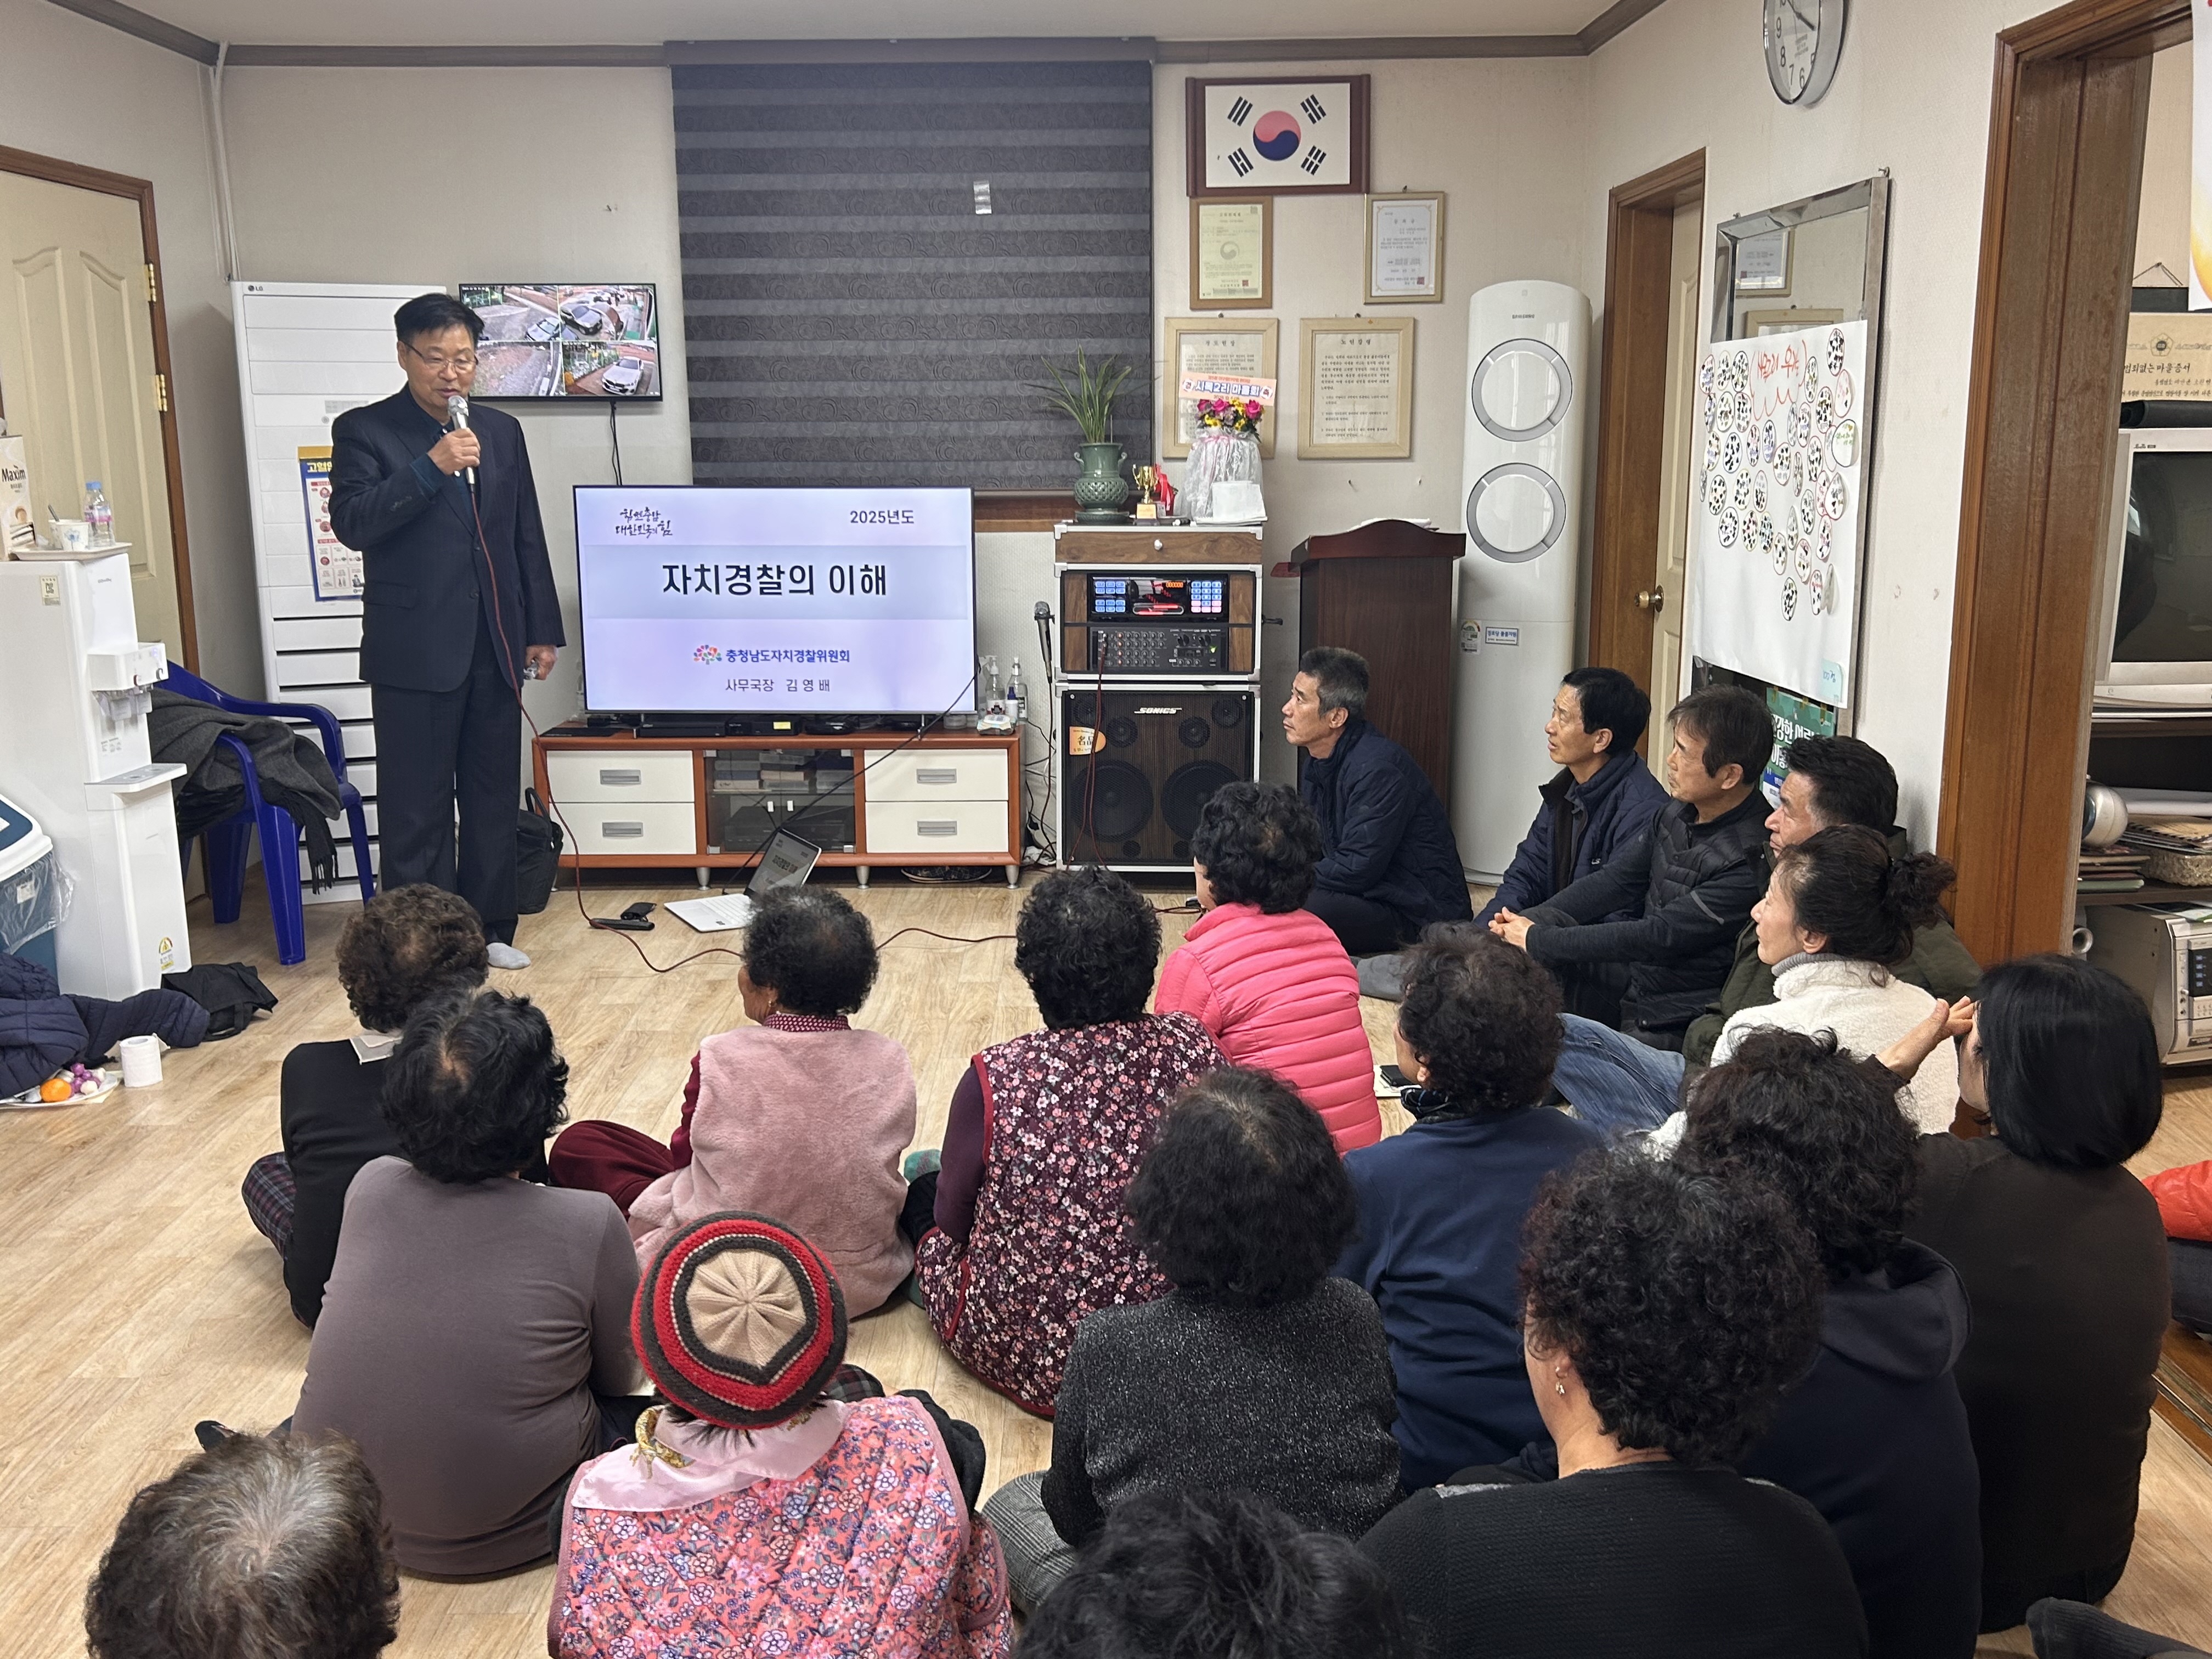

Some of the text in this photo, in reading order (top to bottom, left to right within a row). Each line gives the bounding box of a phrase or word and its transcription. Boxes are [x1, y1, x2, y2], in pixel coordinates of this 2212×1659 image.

[1776, 17, 1782, 38] 9
[1780, 46, 1786, 67] 8
[1789, 64, 1795, 85] 7
[2, 465, 26, 482] Maxim
[850, 510, 915, 525] 2025년도
[662, 563, 887, 596] 자치경찰의 이해
[725, 649, 850, 663] 충청남도자치경찰위원회
[725, 679, 775, 692] 사무국장
